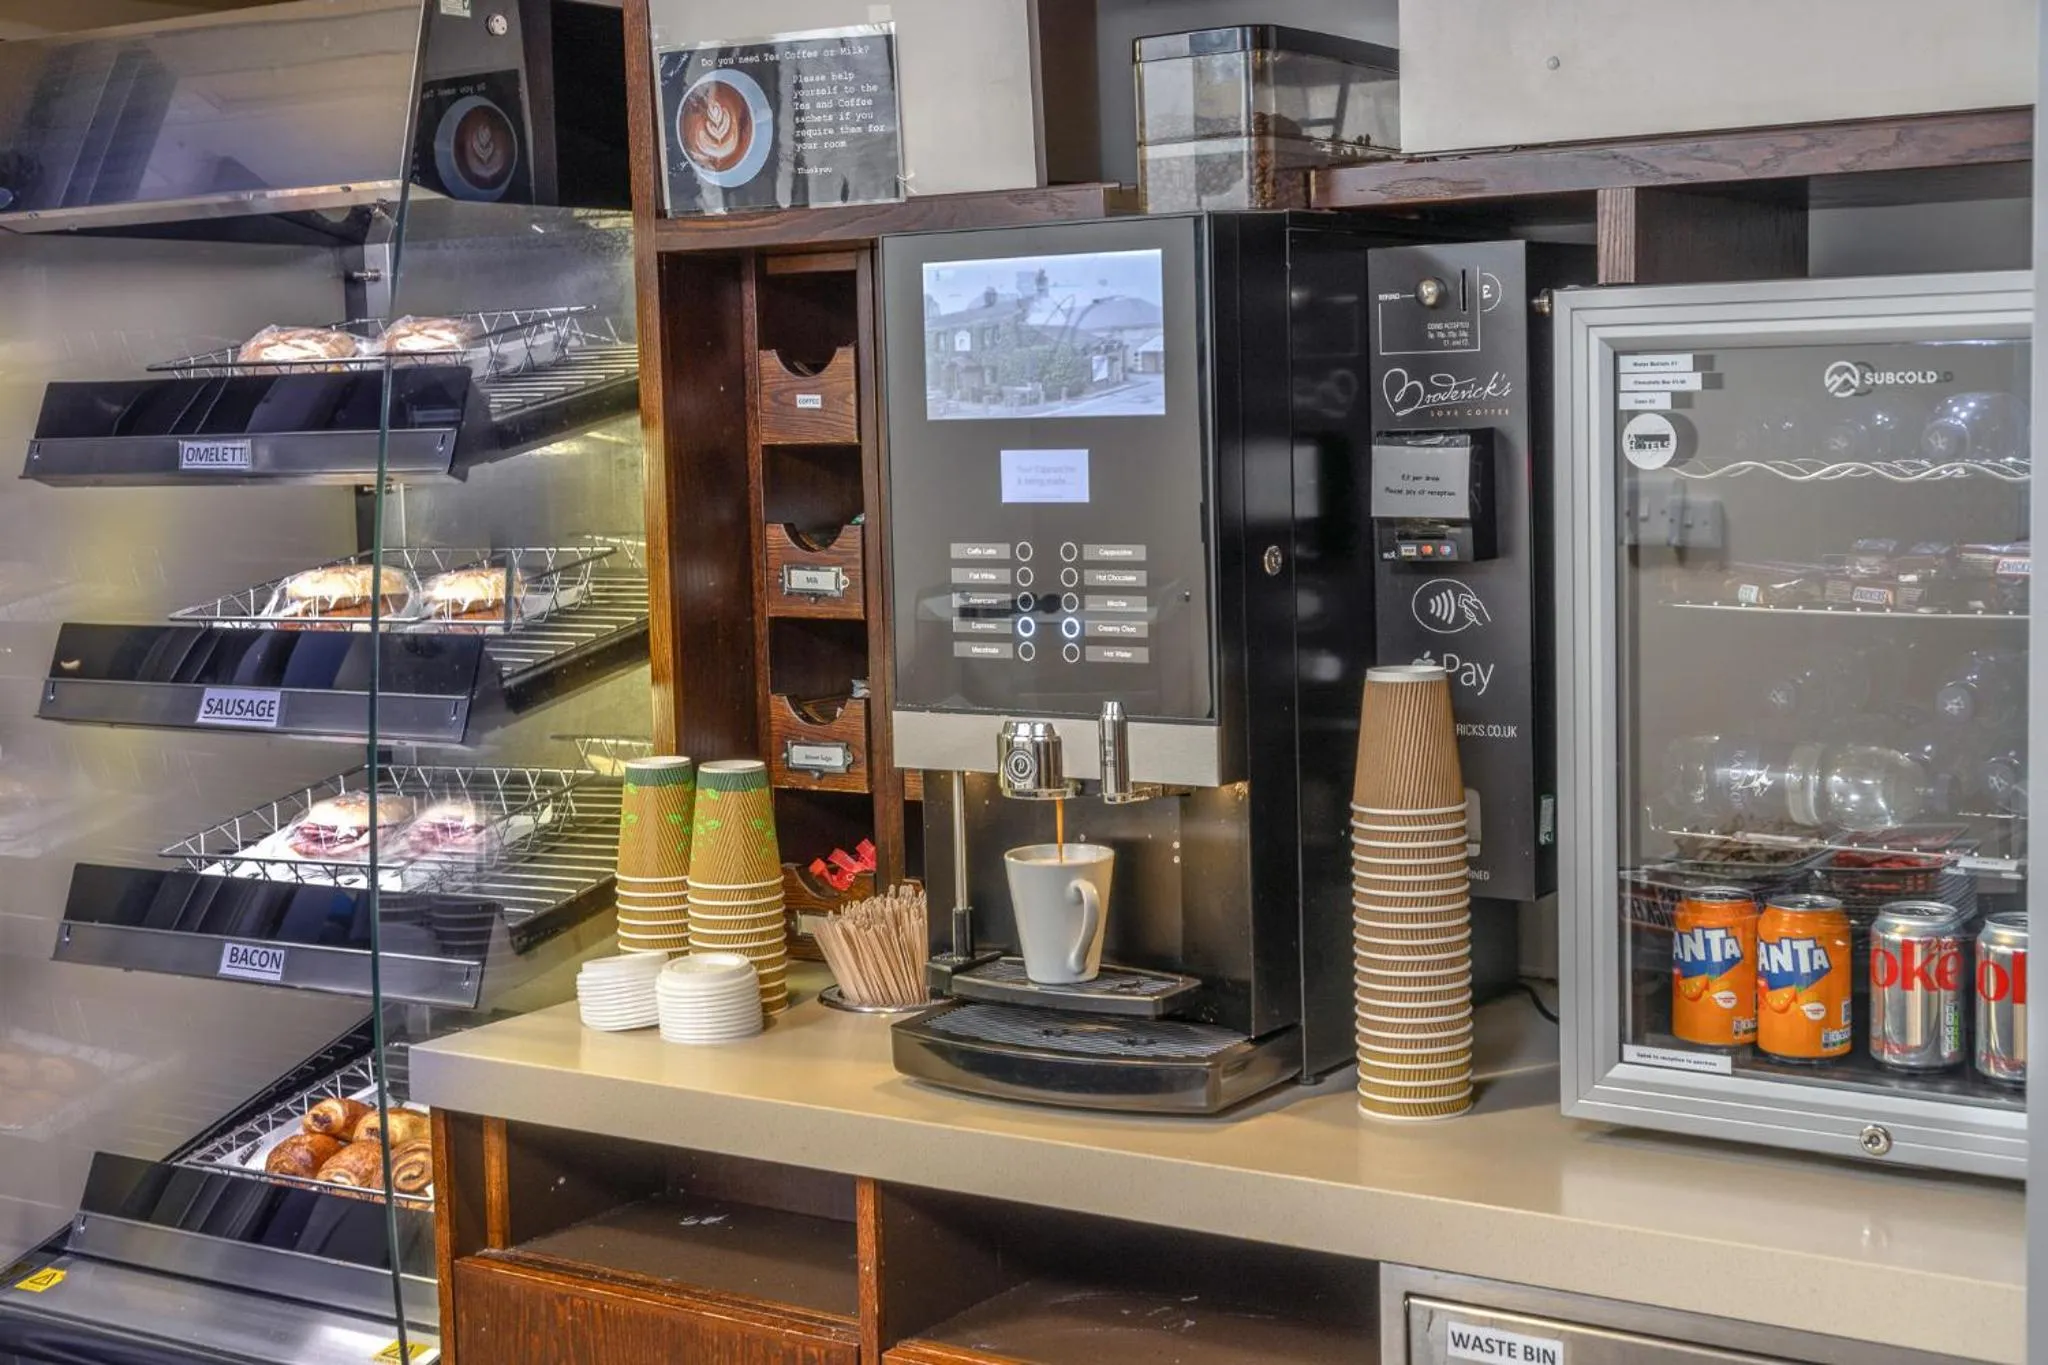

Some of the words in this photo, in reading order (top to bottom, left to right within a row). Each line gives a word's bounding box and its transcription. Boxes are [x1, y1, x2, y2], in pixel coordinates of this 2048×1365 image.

[701, 58, 713, 67] Do
[718, 58, 734, 67] you
[738, 55, 760, 64] need
[764, 53, 779, 62] Tea
[784, 50, 818, 60] Coffee
[823, 49, 835, 57] or
[840, 45, 870, 56] Milk?
[792, 74, 826, 84] Please
[831, 71, 855, 82] help
[792, 86, 838, 99] yourself
[844, 86, 856, 94] to
[861, 83, 879, 92] the
[793, 102, 810, 110] Tea
[816, 99, 833, 109] and
[838, 98, 873, 107] Coffee
[839, 112, 851, 121] if
[856, 112, 874, 122] you
[795, 127, 835, 138] require
[840, 125, 862, 133] them
[868, 124, 886, 133] for
[795, 143, 818, 152] your
[824, 141, 847, 149] room
[1864, 372, 1937, 384] SUBCOLD
[1383, 368, 1513, 417] Broderick's
[1443, 653, 1495, 695] Pay
[204, 698, 276, 717] SAUSAGE
[229, 946, 282, 969] BACON
[1451, 1330, 1517, 1359] WASTE
[1524, 1344, 1556, 1365] BIN
